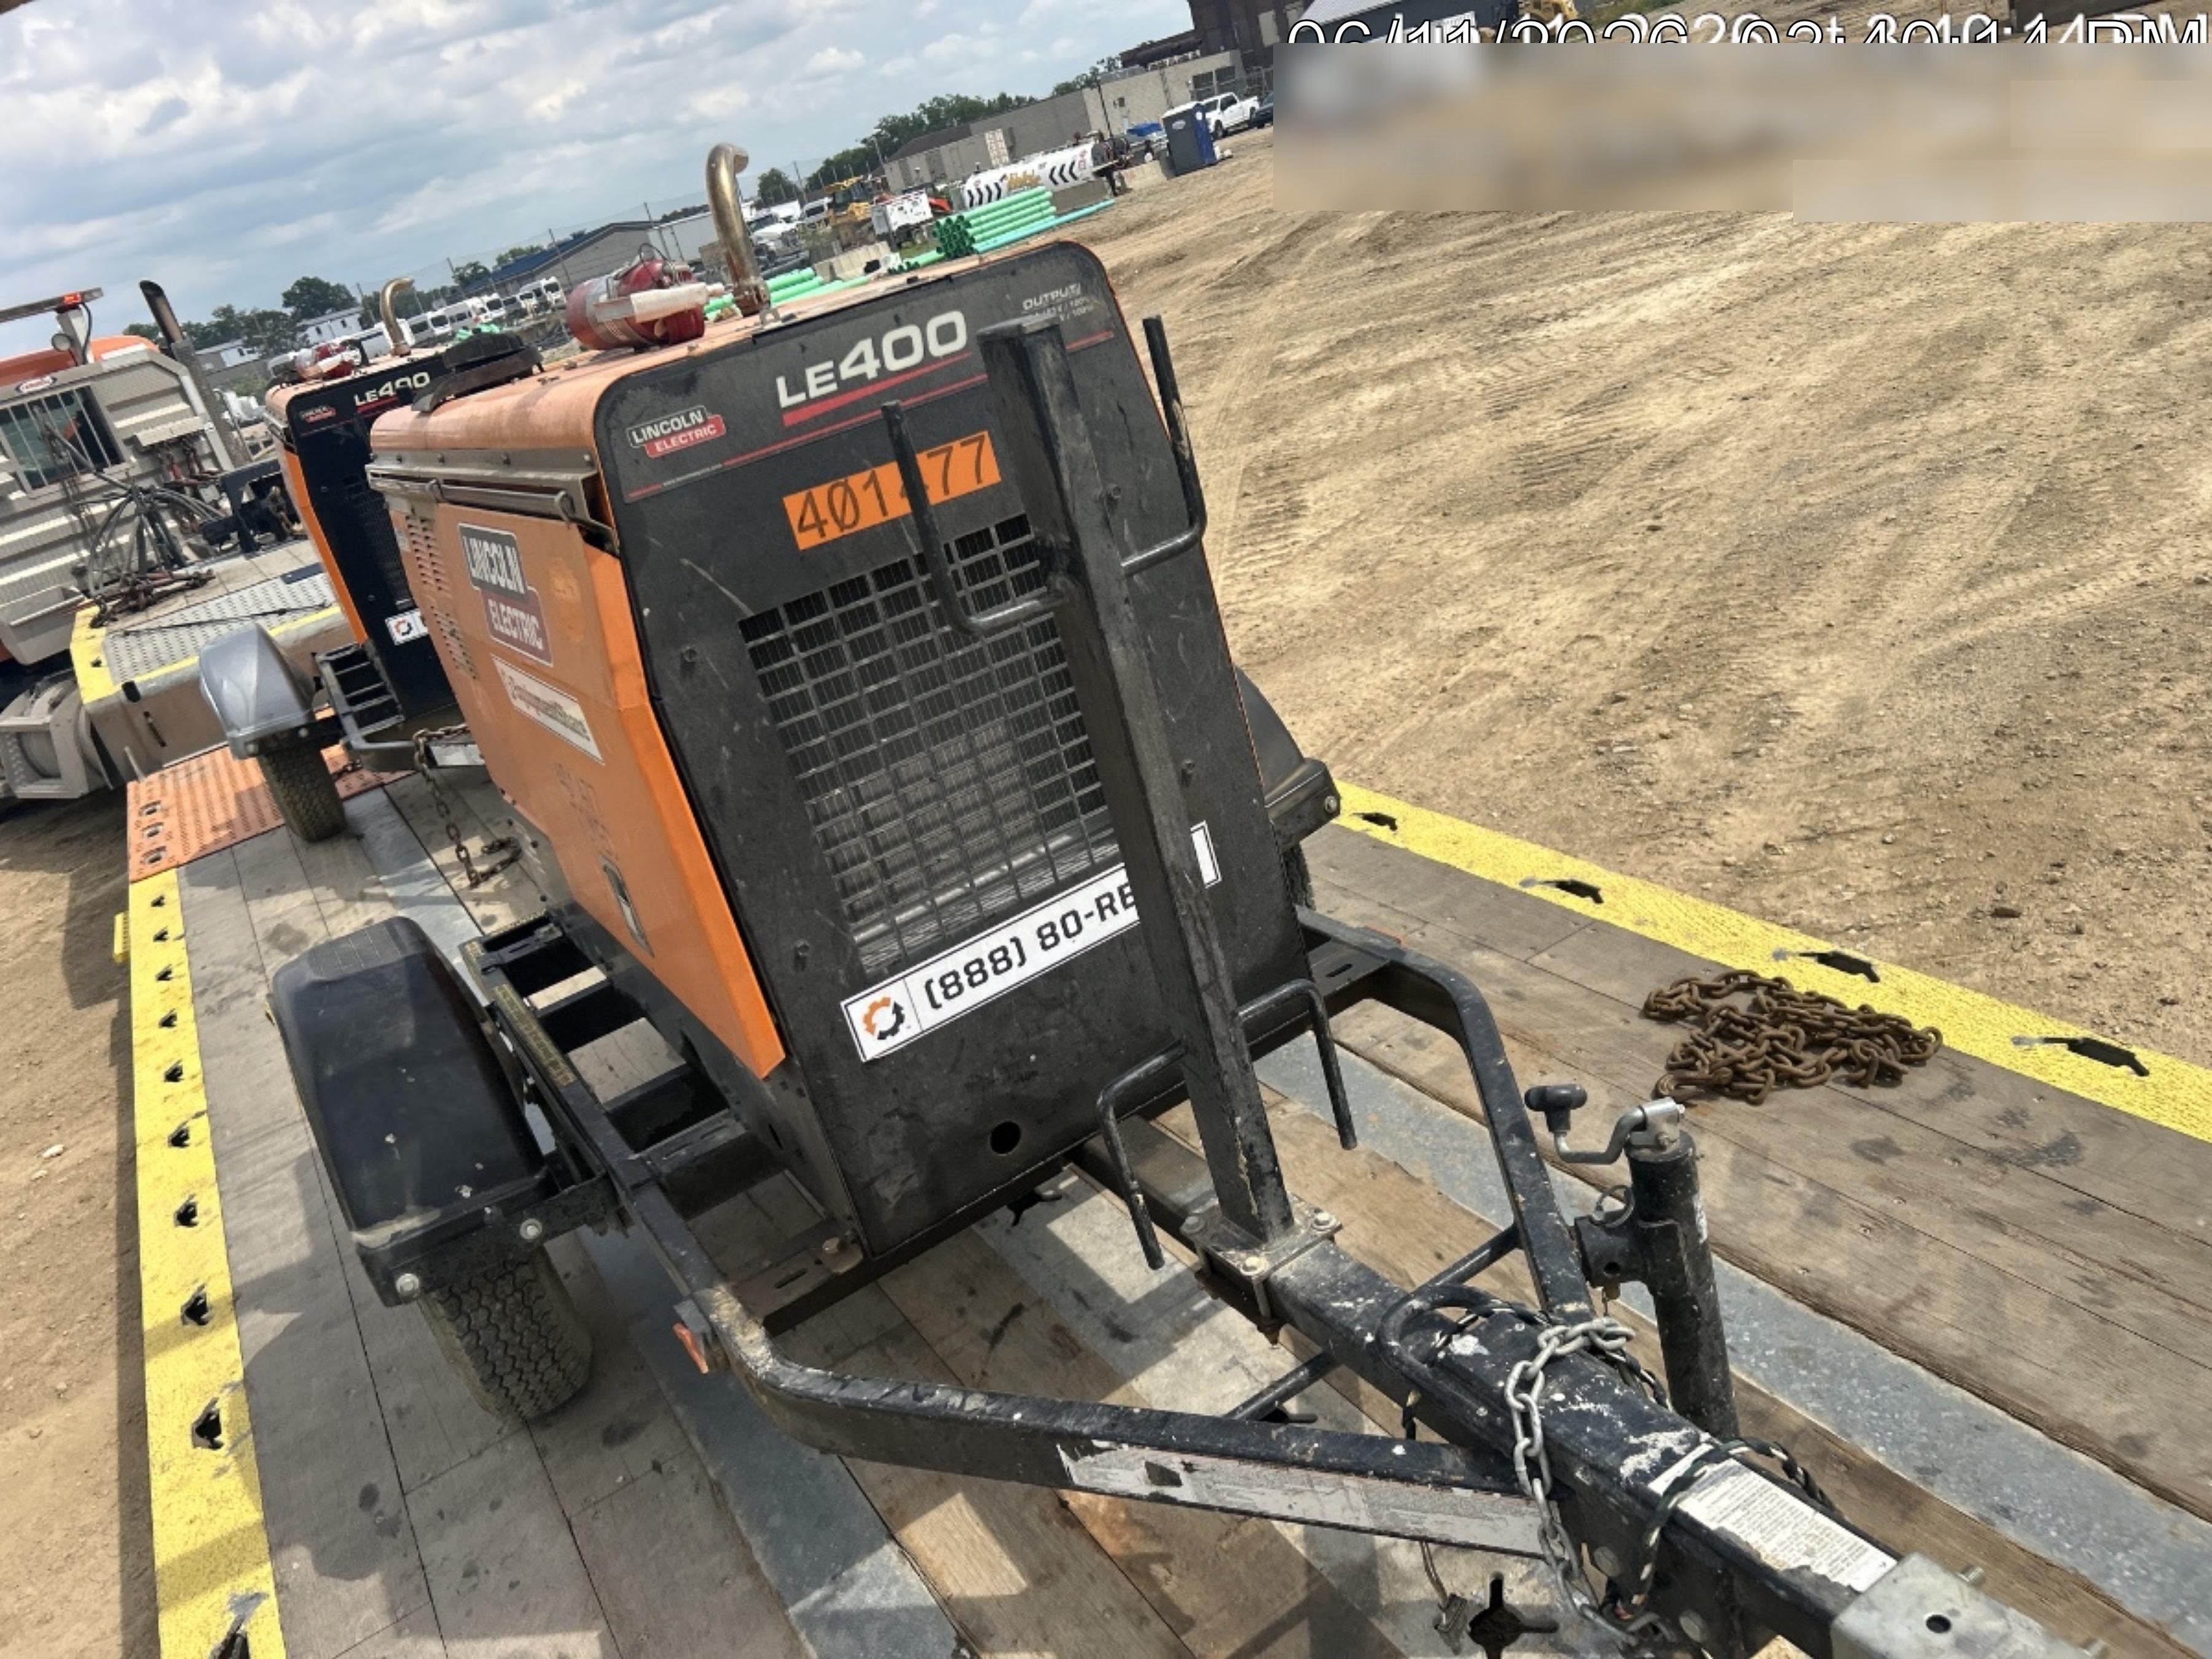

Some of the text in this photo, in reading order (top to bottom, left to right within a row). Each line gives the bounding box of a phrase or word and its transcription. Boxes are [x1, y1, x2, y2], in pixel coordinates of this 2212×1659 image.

[776, 311, 967, 408] LE400
[632, 410, 704, 443] LINCOLN
[655, 425, 718, 452] ELECTRIC
[798, 434, 984, 538] 40177
[463, 536, 525, 594] LINCOLN
[488, 598, 543, 649] ELECTRIC
[924, 936, 1027, 1010] (888)
